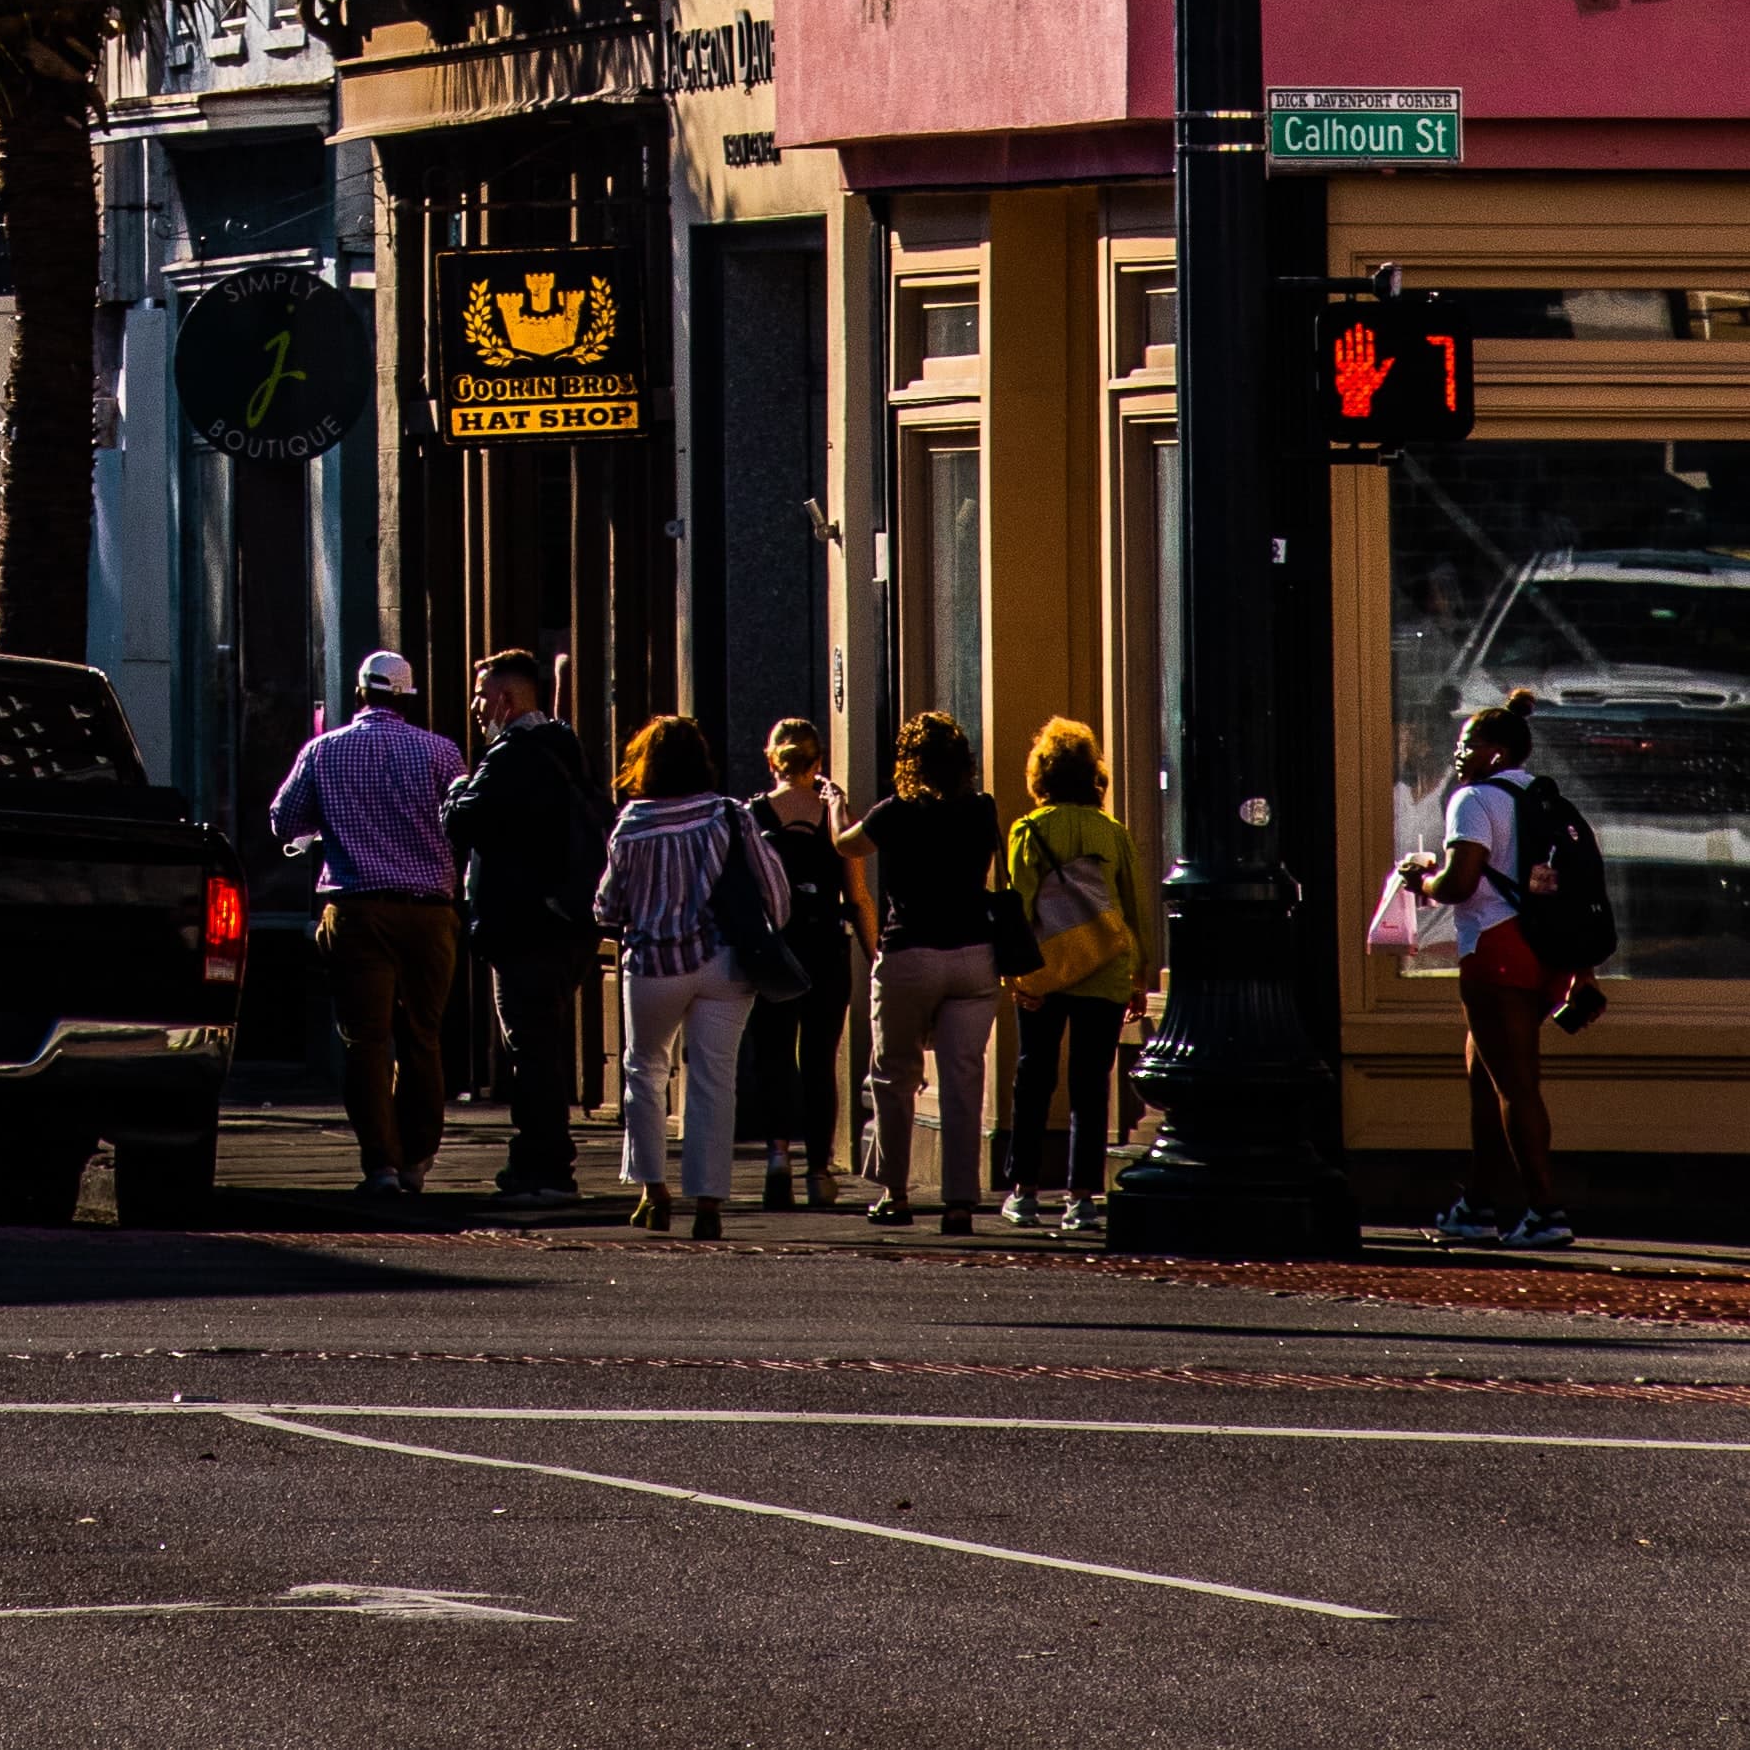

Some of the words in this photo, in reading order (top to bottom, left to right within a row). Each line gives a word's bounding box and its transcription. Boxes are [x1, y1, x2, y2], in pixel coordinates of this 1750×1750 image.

[663, 19, 736, 93] JACKSON
[1274, 93, 1308, 108] DICK
[1313, 93, 1392, 108] DAVENPORT
[1396, 93, 1453, 108] CORNER
[1284, 116, 1404, 152] Calhoun
[1415, 117, 1447, 154] St
[222, 271, 322, 304] SIMPLY
[450, 373, 557, 403] GOORIN
[1424, 333, 1458, 414] 7
[458, 410, 531, 432] HAT
[539, 406, 634, 428] SHOP
[207, 413, 345, 461] BOUTIQUE
